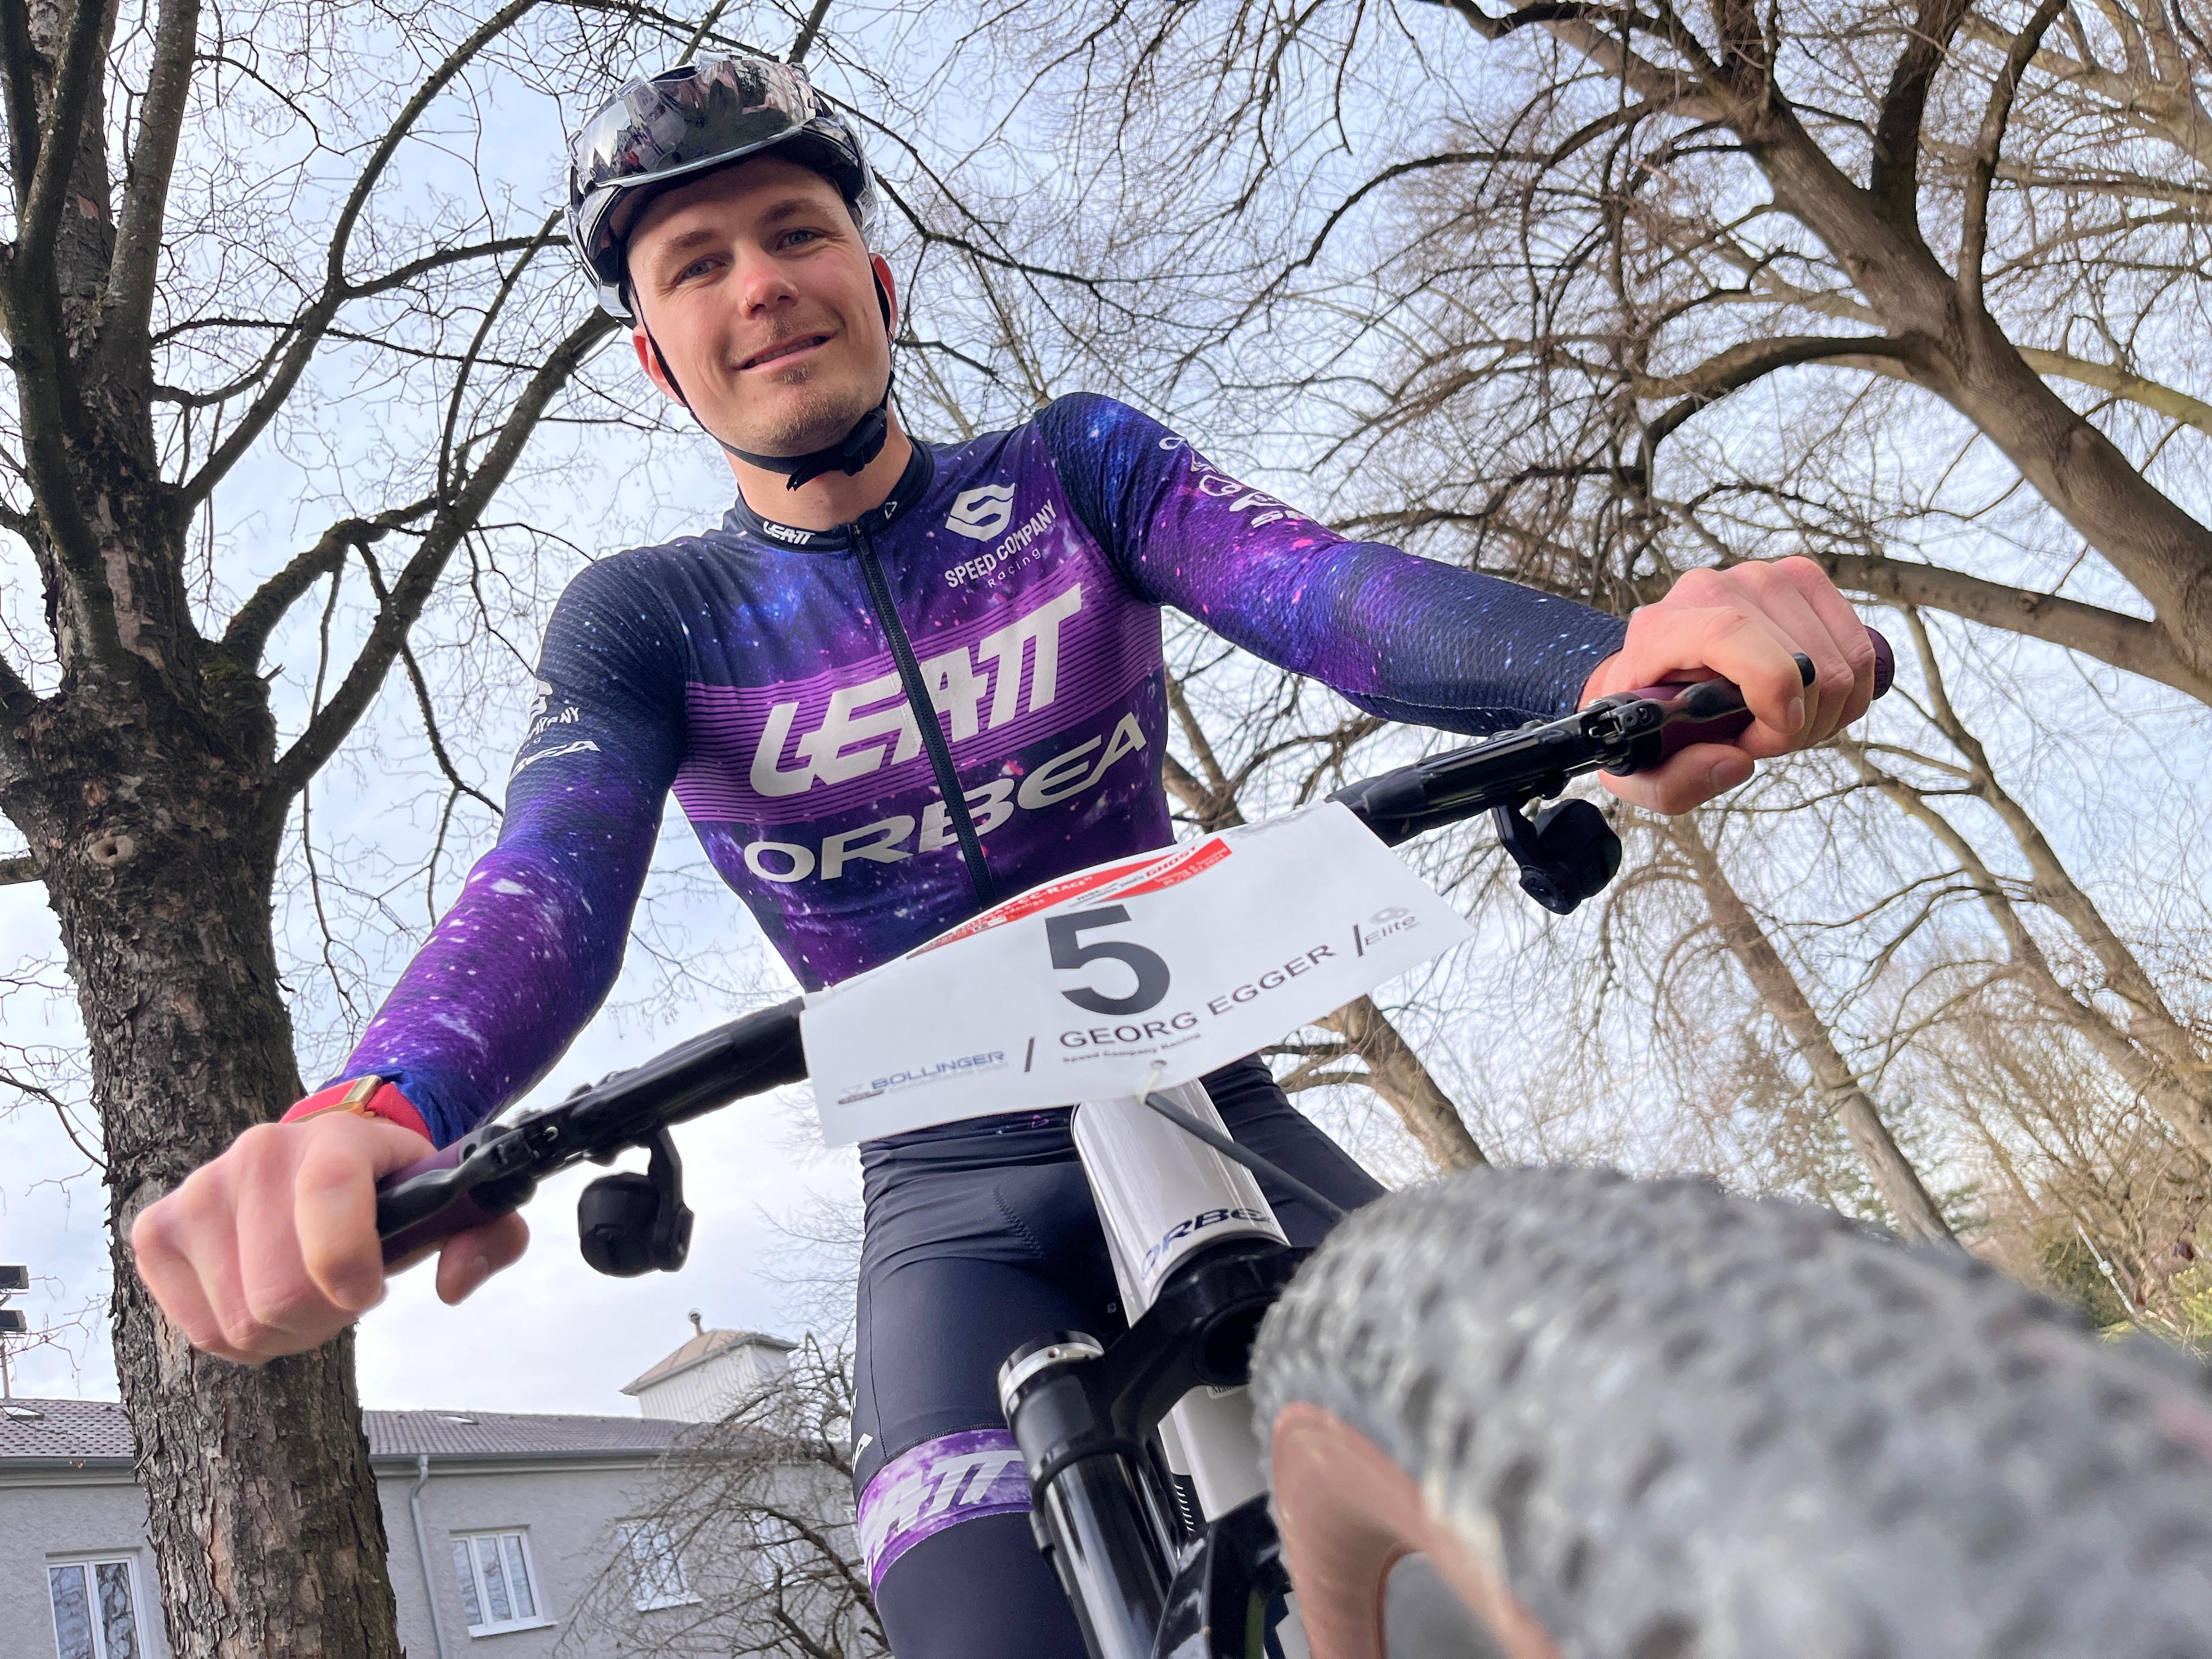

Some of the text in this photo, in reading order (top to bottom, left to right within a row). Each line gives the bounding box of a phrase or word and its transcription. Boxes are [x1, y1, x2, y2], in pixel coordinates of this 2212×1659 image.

[763, 521, 816, 545] LEATT
[944, 499, 1057, 588] SPEED COMPANY
[988, 548, 1041, 588] Racing
[749, 583, 1082, 798] LEATT
[743, 712, 1147, 883] ORBEA
[1045, 904, 1171, 1015] 5
[1365, 916, 1415, 945] Elite
[1060, 944, 1336, 1047] GEORG EGGER
[872, 1051, 1005, 1090] BOLLINGER
[1103, 1047, 1157, 1057] Company
